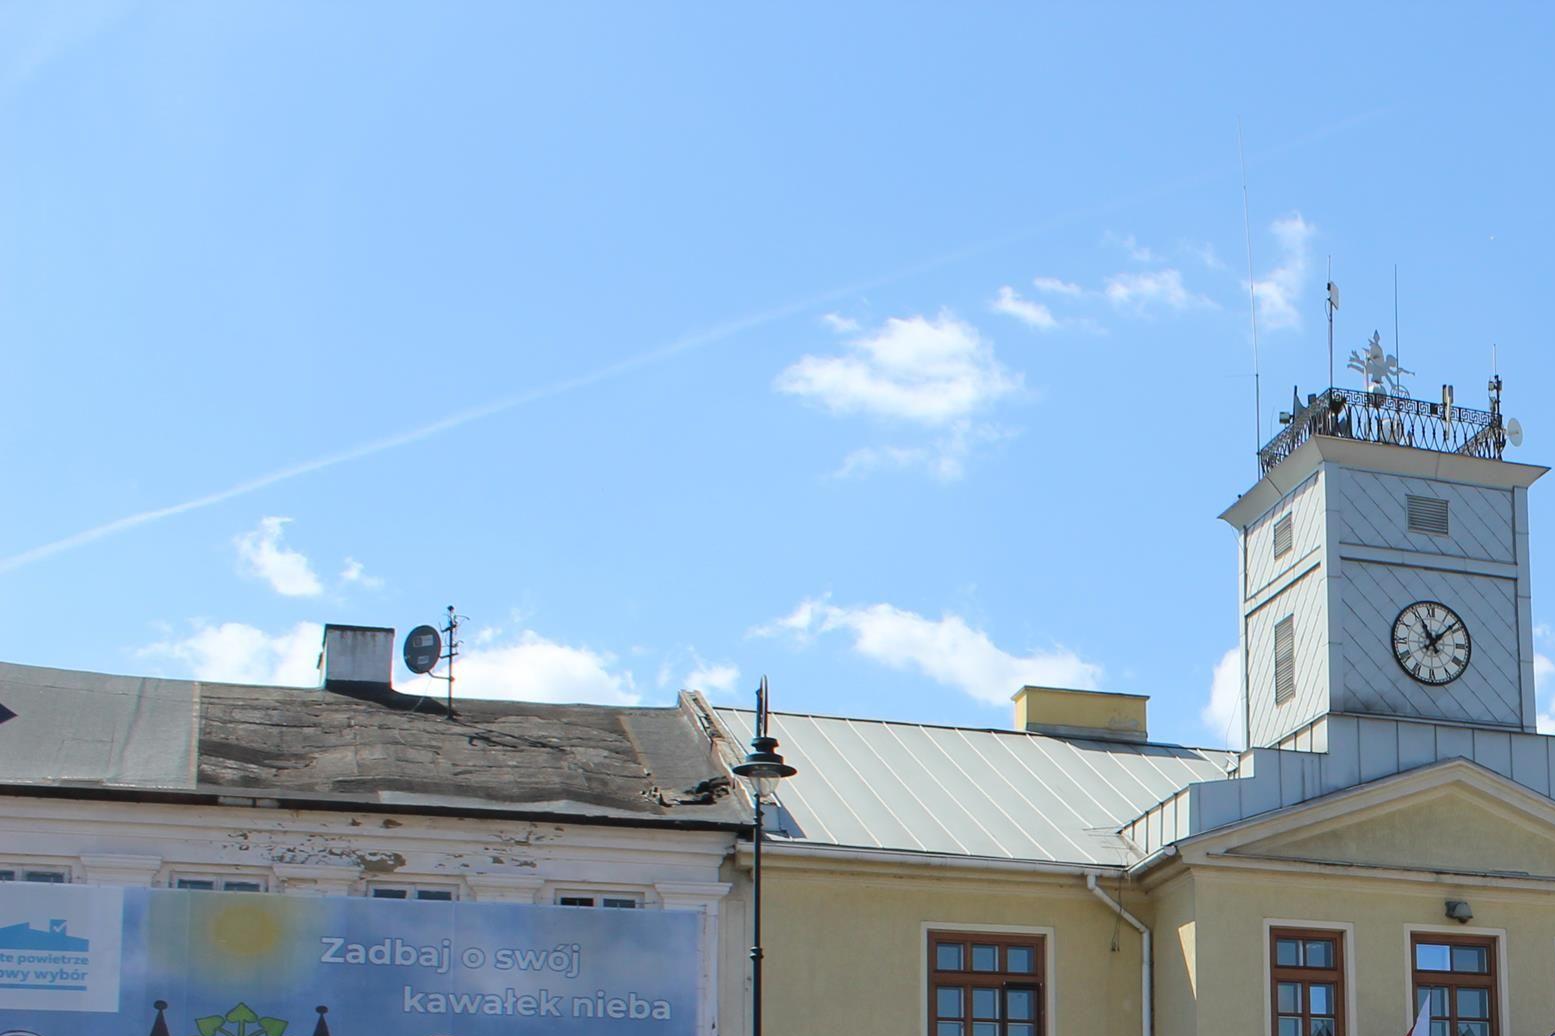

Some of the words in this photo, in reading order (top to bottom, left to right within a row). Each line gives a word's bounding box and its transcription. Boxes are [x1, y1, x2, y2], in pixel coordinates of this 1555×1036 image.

[17, 953, 89, 969] powietrze
[319, 936, 452, 975] Zadbaj
[461, 946, 486, 969] o
[494, 942, 582, 978] swój
[34, 968, 88, 983] wybór
[402, 985, 564, 1018] kawałek
[571, 990, 672, 1021] nieba
